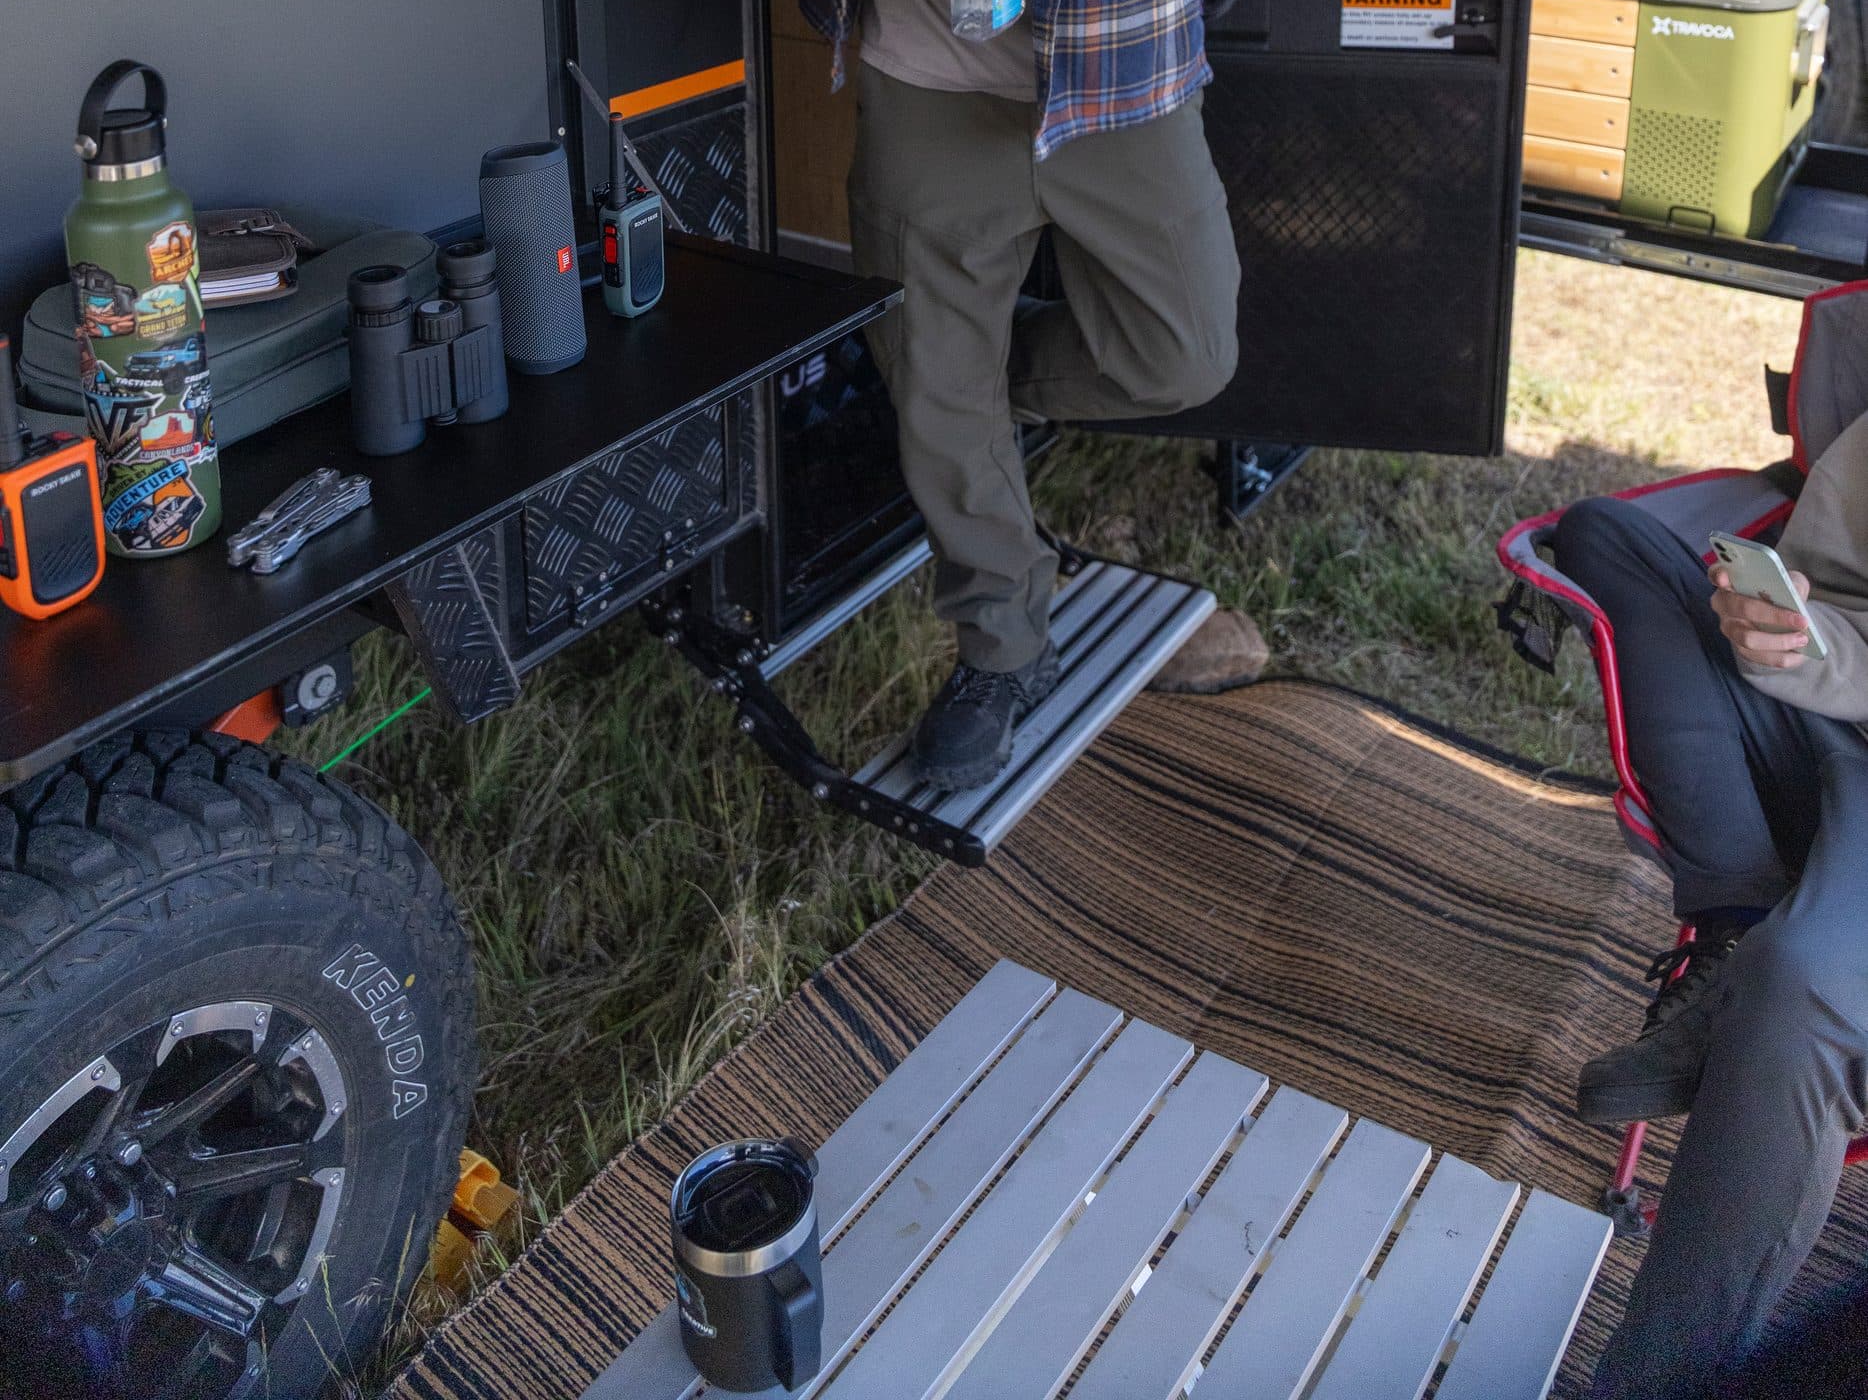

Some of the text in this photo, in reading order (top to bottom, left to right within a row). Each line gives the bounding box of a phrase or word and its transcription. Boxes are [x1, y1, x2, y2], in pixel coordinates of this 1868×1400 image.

[562, 251, 571, 269] JBL
[115, 376, 164, 388] TACTICAL
[140, 444, 195, 460] CANYONLANDS
[106, 463, 183, 525] ADVENTURE
[322, 943, 428, 1120] KENDA
